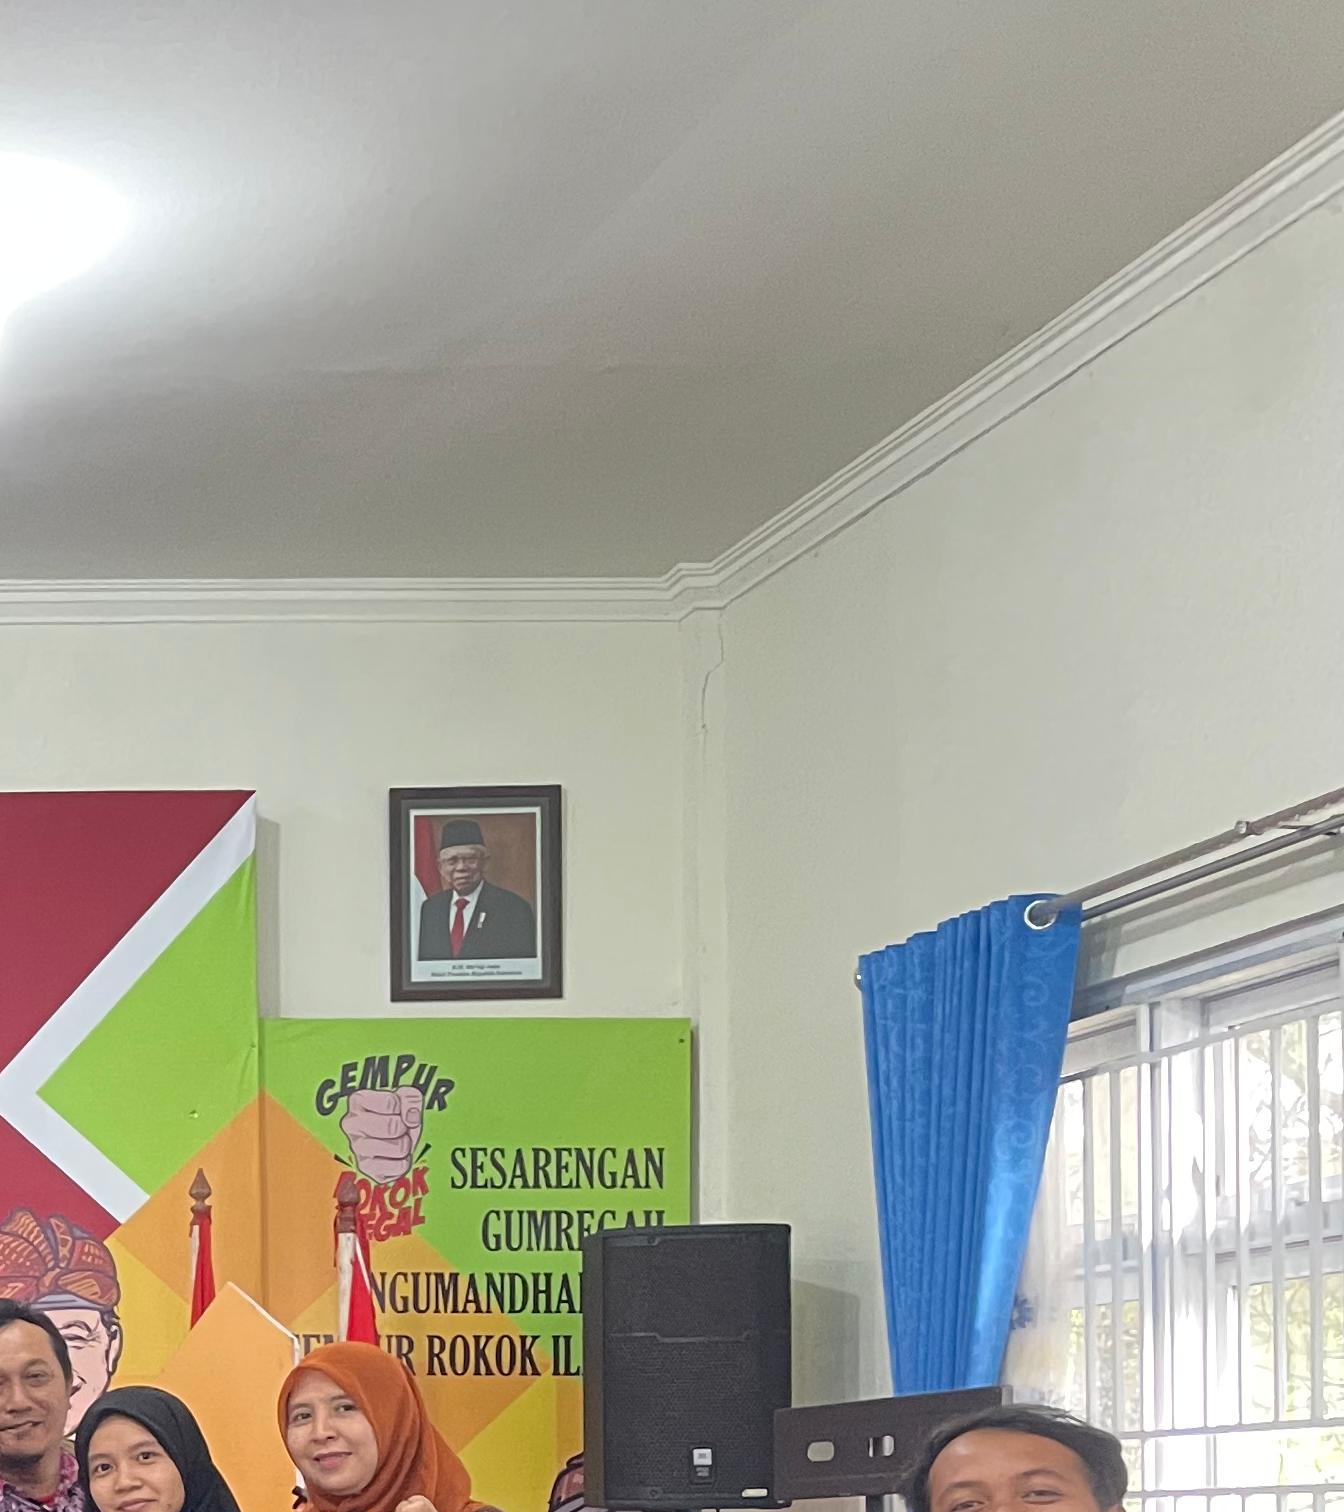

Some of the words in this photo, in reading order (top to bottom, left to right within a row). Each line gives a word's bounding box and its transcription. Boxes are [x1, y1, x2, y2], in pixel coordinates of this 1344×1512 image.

[315, 1053, 456, 1117] GEMPUR
[450, 1147, 665, 1190] SESARENGAN
[370, 1271, 583, 1315] NGUMANDHA
[426, 1334, 542, 1377] ROKOK
